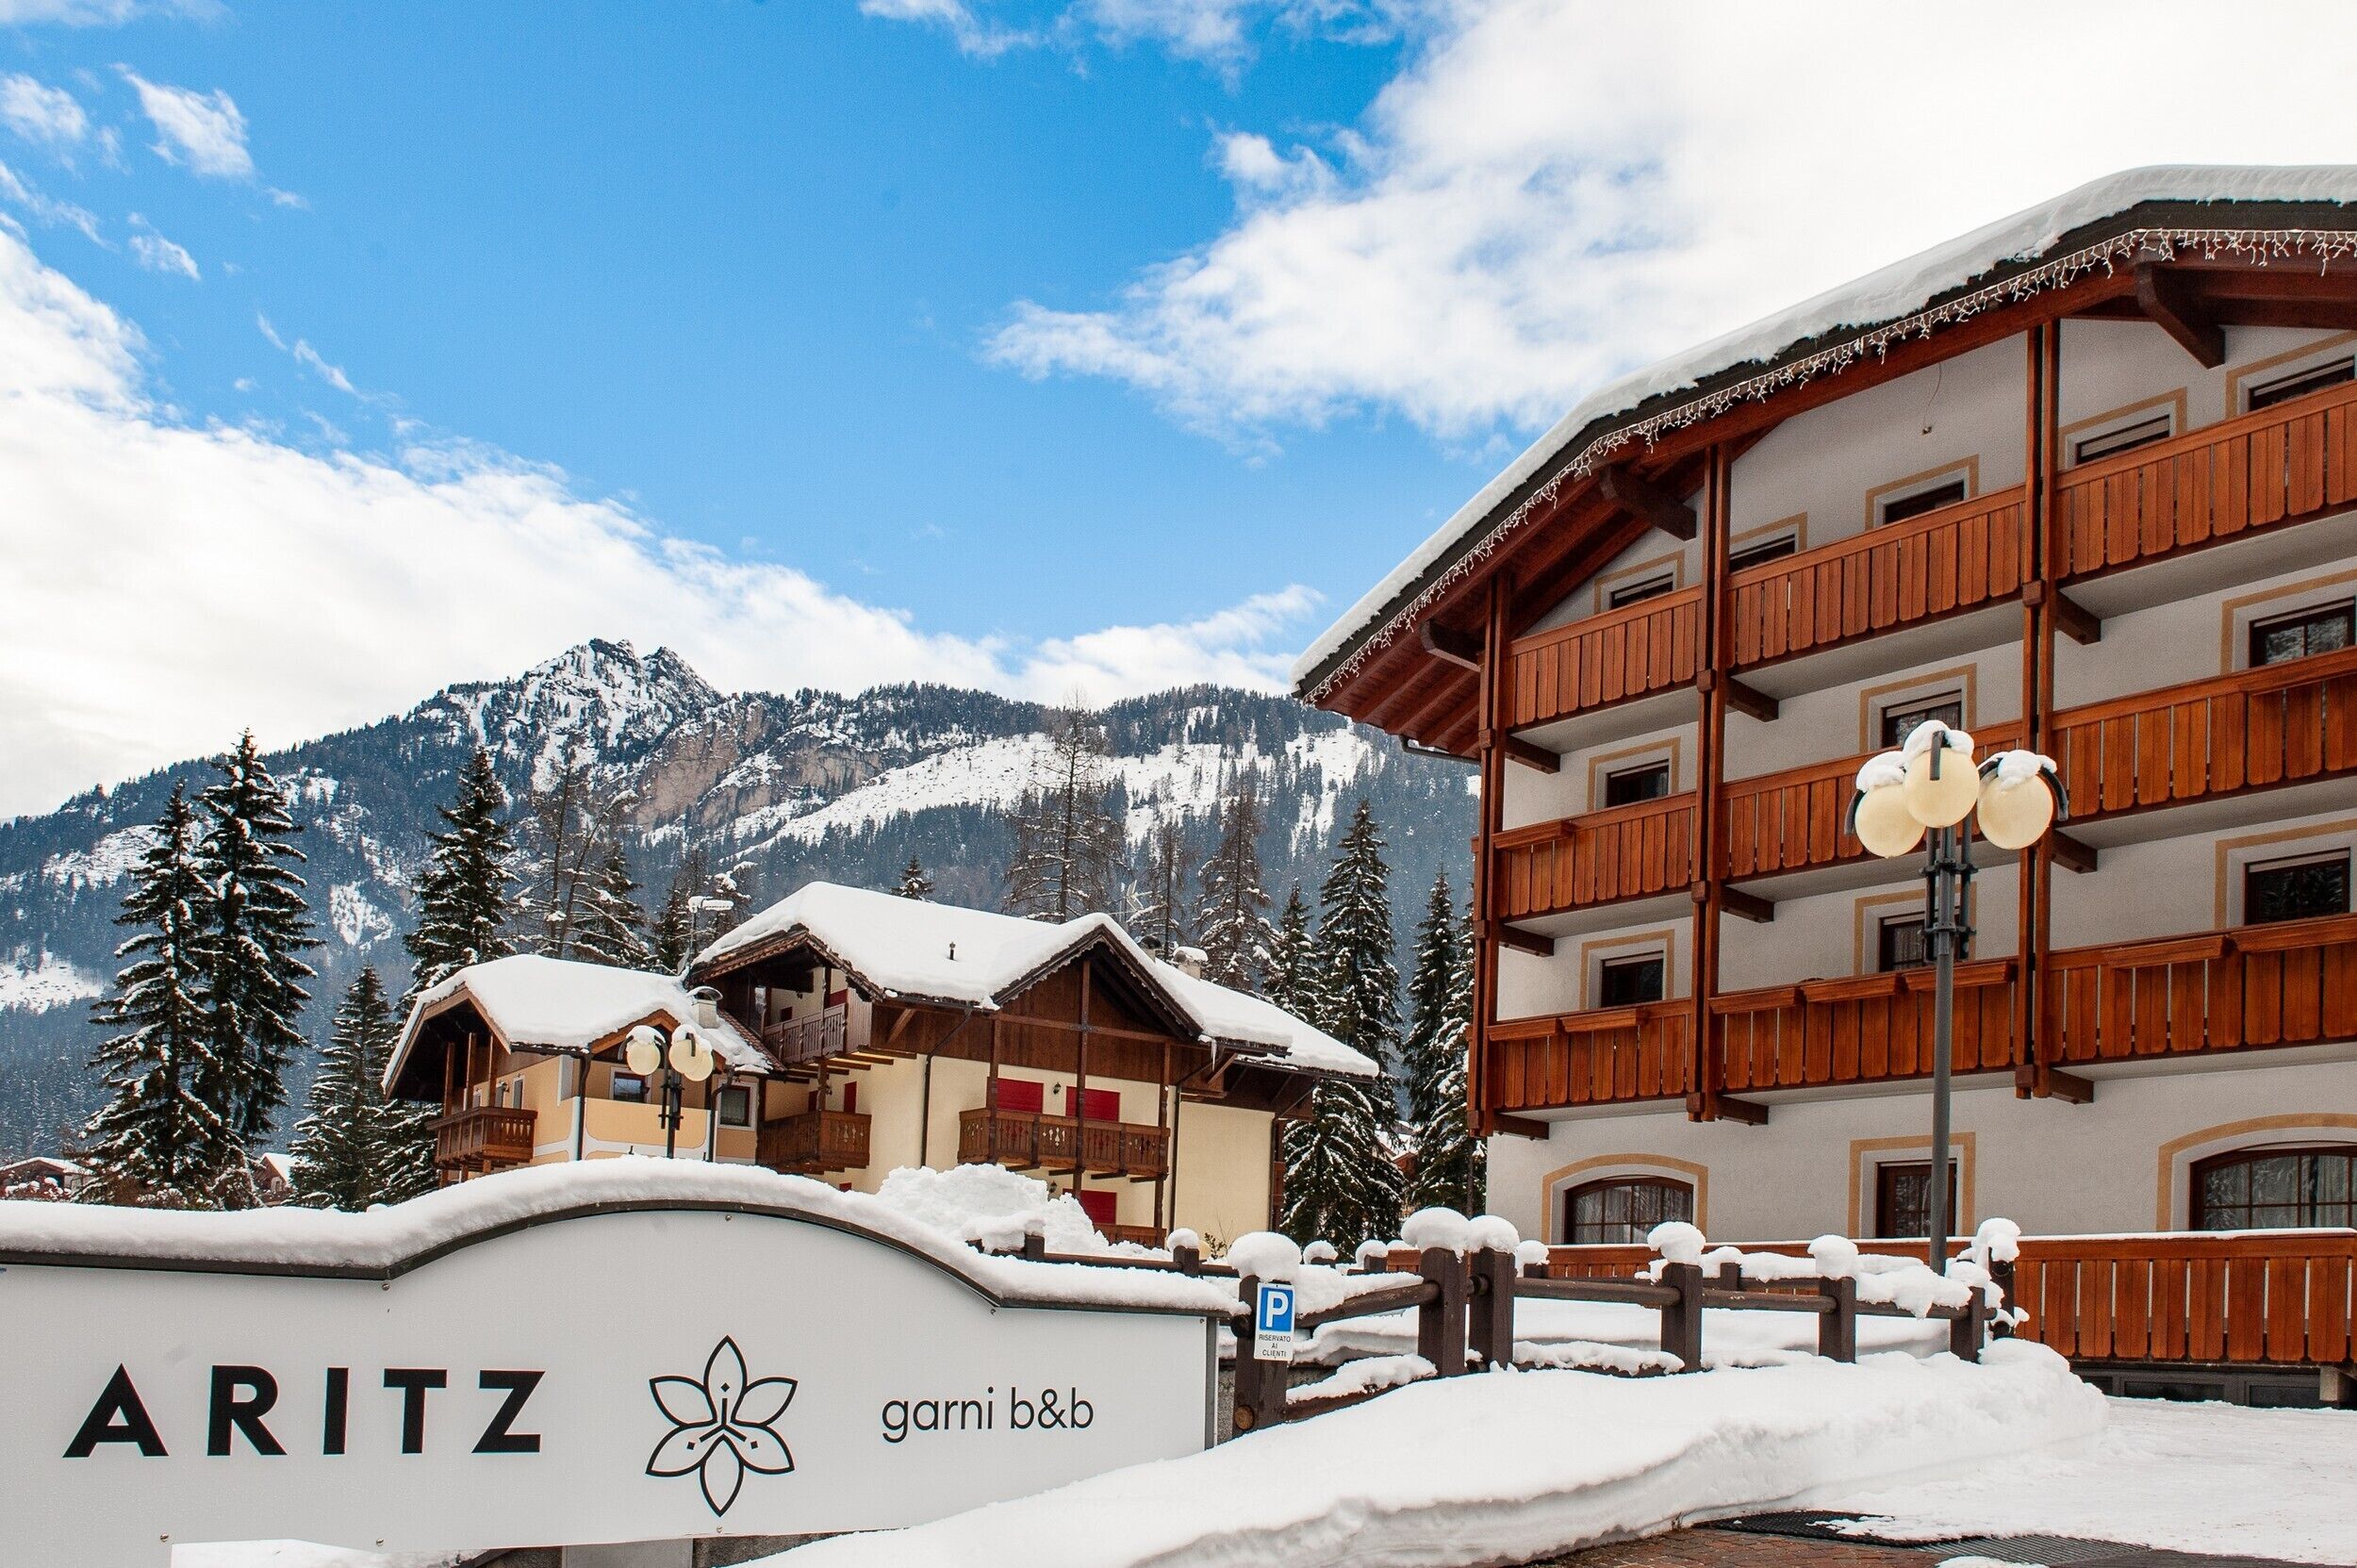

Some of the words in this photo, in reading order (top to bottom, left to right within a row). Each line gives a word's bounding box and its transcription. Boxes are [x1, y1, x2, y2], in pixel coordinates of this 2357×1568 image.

[1266, 1291, 1289, 1328] P
[1259, 1334, 1291, 1343] RISERVATO
[63, 1363, 546, 1459] ARITZ
[882, 1386, 994, 1444] garni
[1010, 1386, 1094, 1430] b&b
